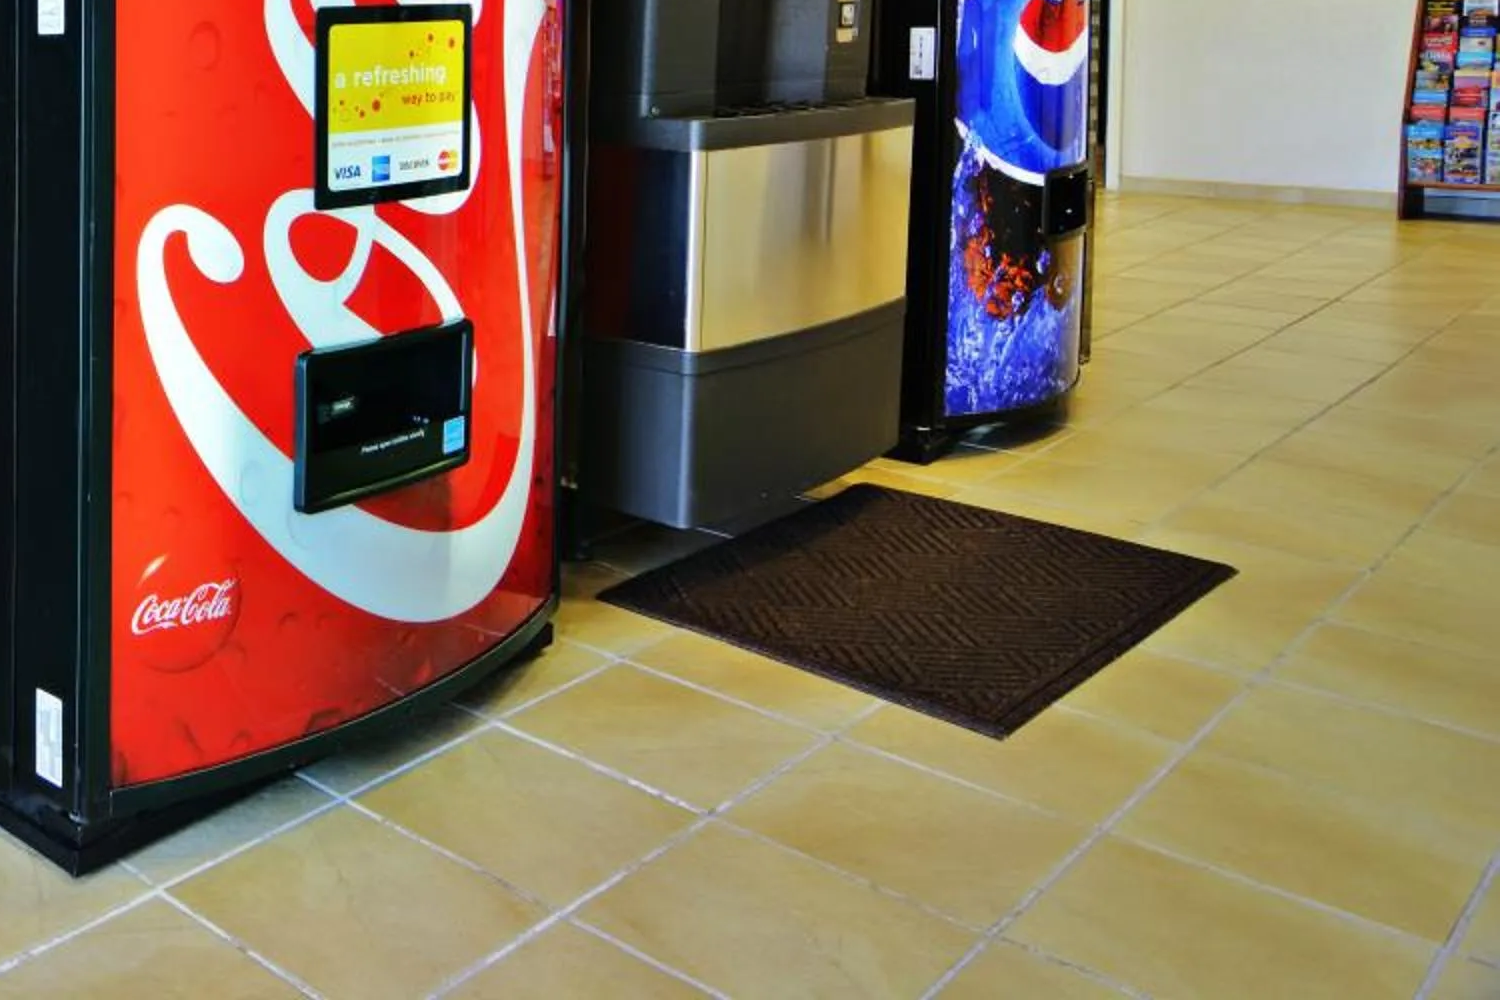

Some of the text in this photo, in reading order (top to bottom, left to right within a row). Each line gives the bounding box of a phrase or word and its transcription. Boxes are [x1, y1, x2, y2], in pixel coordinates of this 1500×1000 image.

[335, 63, 448, 89] a refreshing
[401, 91, 455, 107] way to pay
[335, 165, 361, 180] VISA
[131, 578, 237, 636] Coca-Cola
